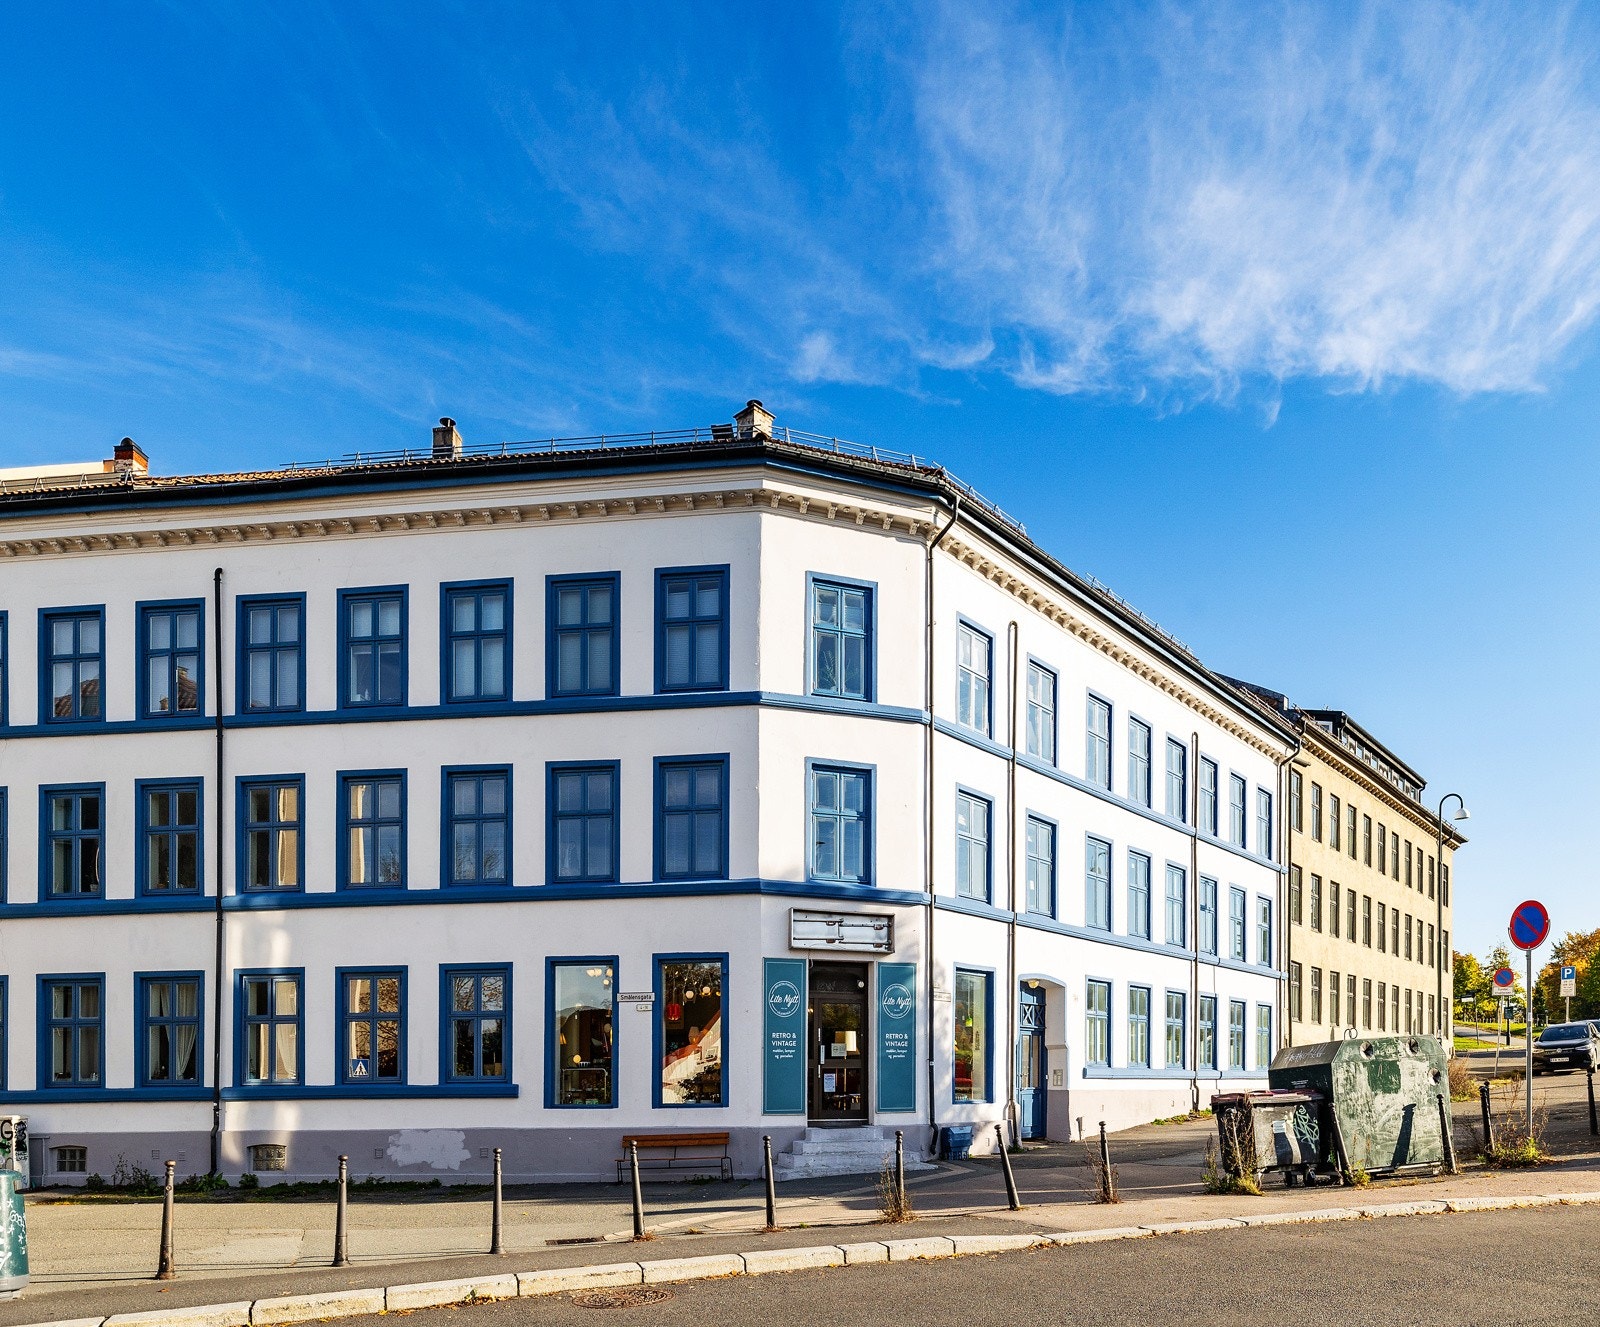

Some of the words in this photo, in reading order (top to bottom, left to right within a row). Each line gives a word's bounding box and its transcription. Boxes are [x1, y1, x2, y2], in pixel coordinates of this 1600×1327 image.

[1564, 968, 1572, 978] P
[770, 994, 783, 1003] Lite
[783, 994, 798, 1007] Nytt
[883, 997, 895, 1005] Lite
[895, 997, 911, 1009] Nytt
